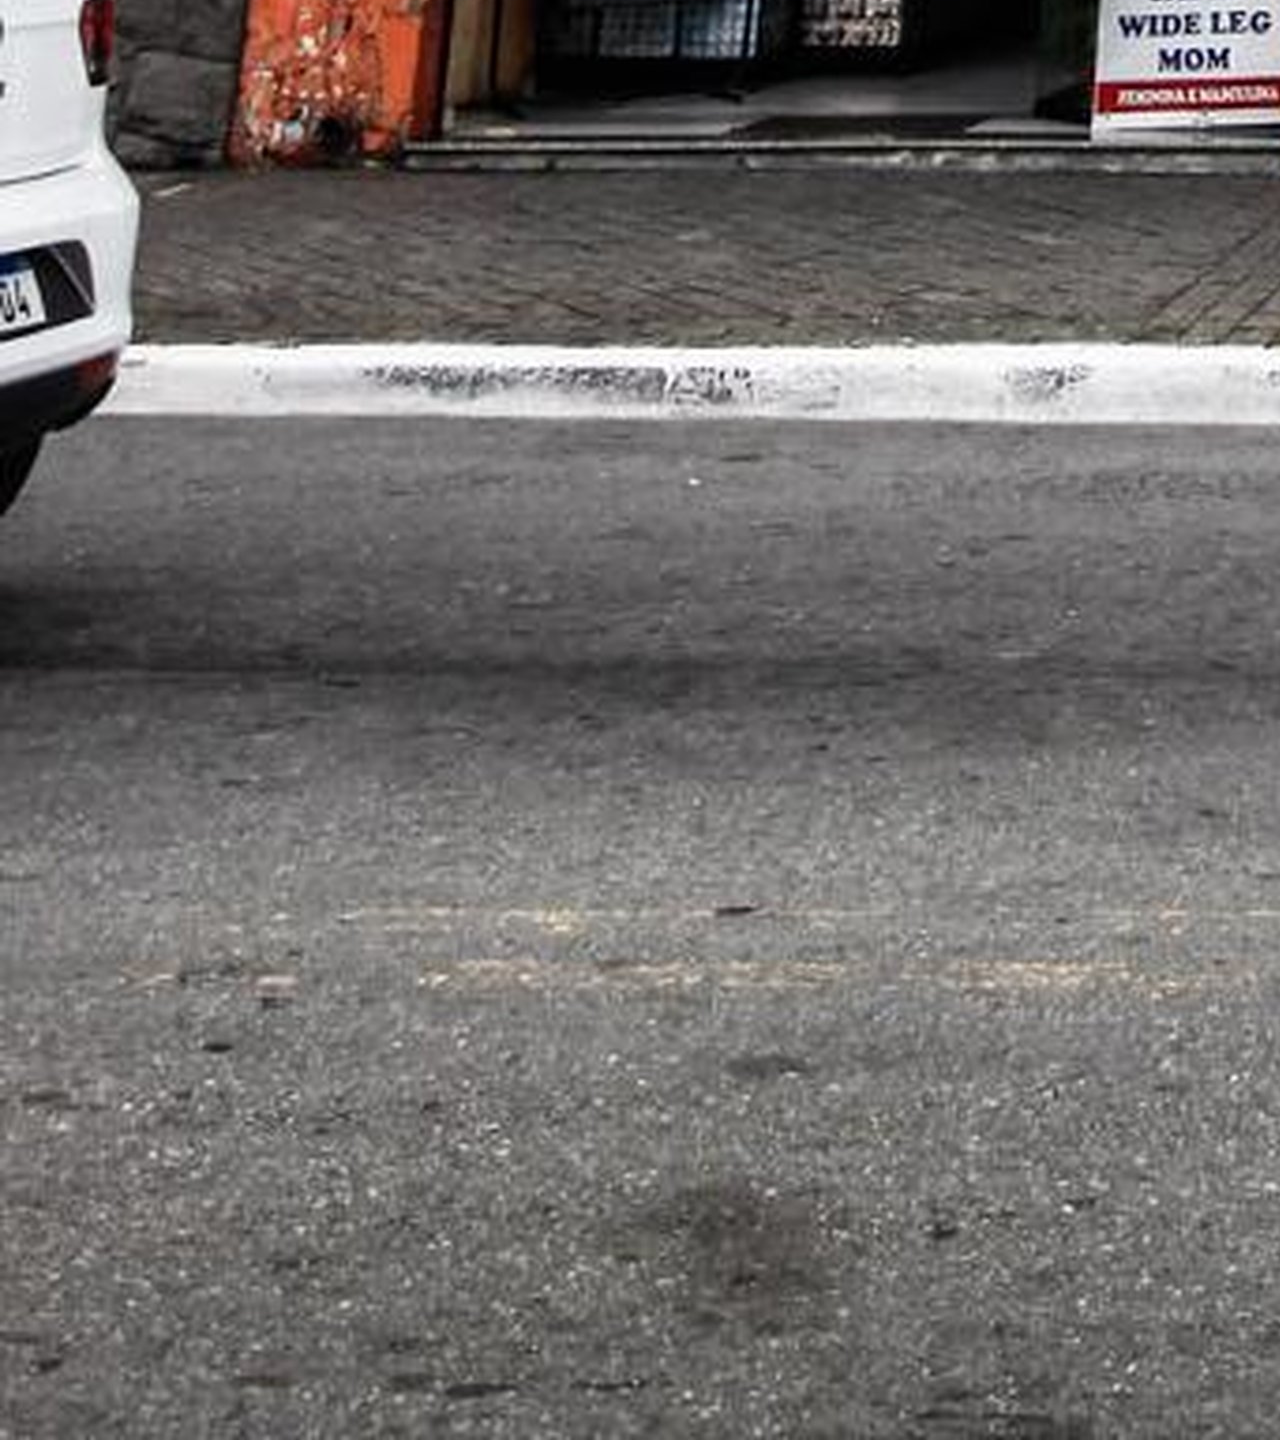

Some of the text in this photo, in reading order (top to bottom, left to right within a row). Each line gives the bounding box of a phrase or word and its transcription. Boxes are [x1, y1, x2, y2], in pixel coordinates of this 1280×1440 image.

[1118, 10, 1273, 39] WIDE LEG
[1158, 47, 1231, 73] MOM
